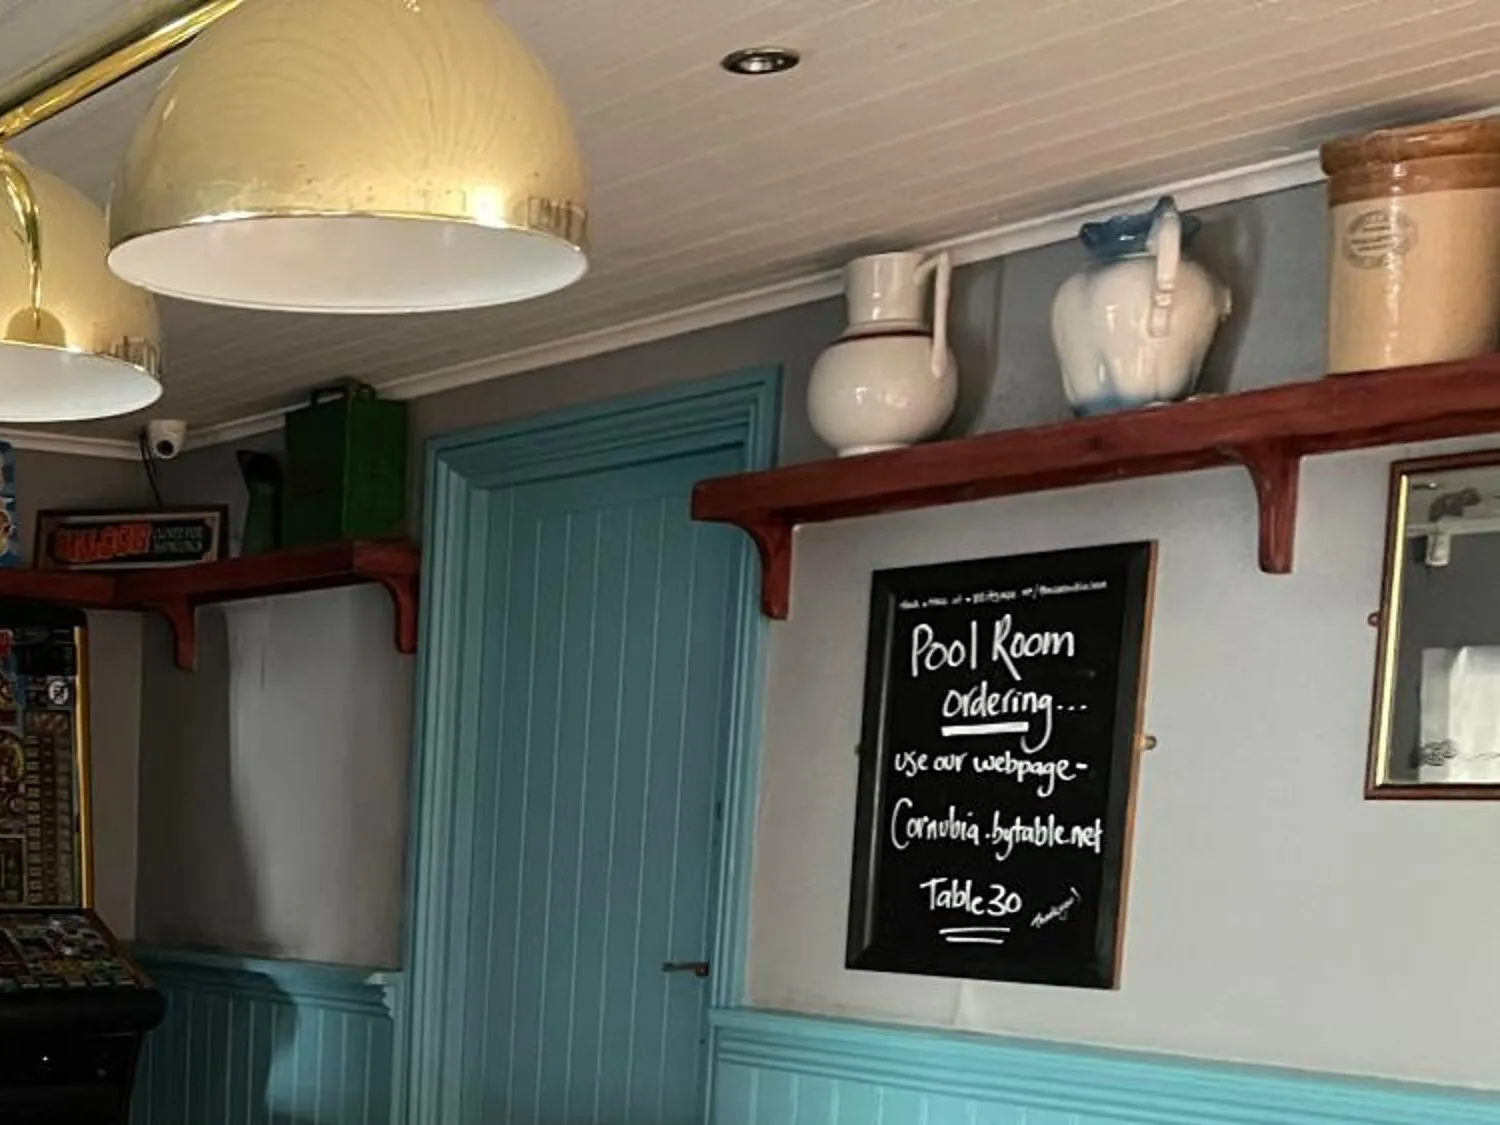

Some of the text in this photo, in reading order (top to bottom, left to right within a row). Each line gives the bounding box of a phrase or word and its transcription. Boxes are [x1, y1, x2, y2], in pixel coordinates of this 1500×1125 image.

[911, 612, 1076, 681] Pool Room
[894, 750, 929, 778] use
[933, 752, 968, 773] our
[918, 876, 1023, 918] Table 30
